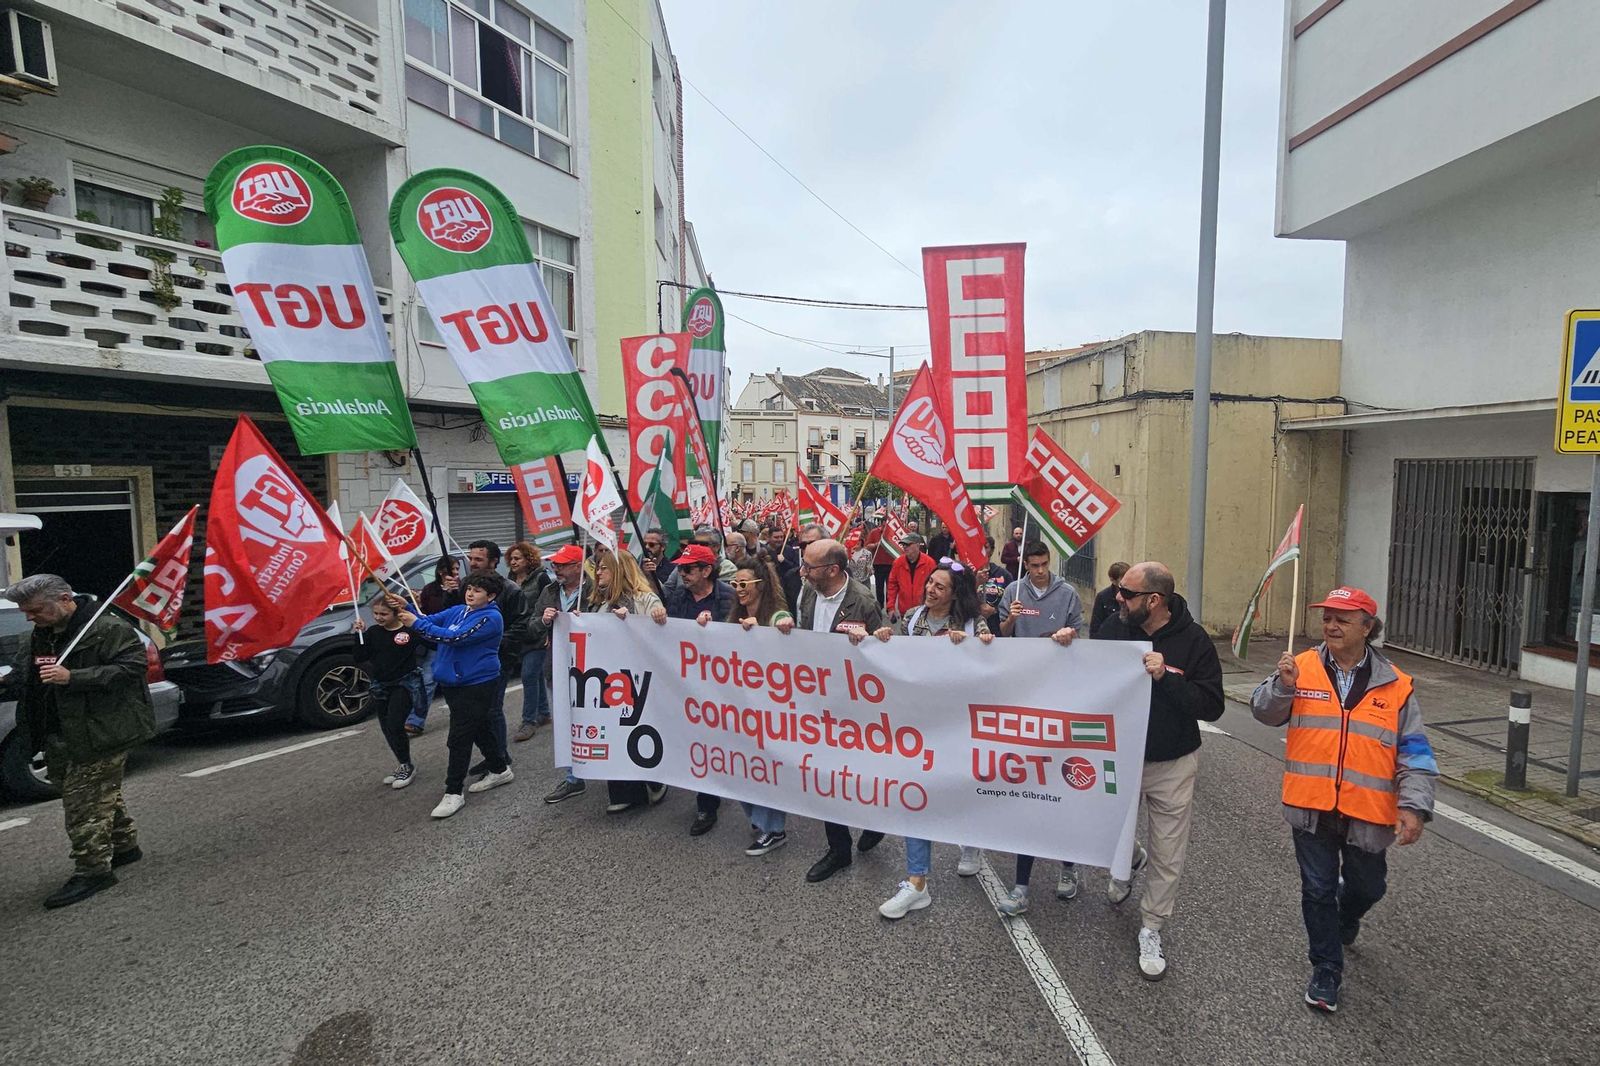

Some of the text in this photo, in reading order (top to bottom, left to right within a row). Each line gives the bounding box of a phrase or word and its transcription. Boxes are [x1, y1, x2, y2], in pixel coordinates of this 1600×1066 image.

[946, 257, 1009, 483] CCOO
[62, 466, 83, 477] 59
[1025, 438, 1109, 525] CCOO
[1050, 498, 1091, 538] Cádiz
[680, 641, 885, 703] Proteger lo
[571, 723, 583, 738] GT
[684, 697, 935, 771] conquistado,
[976, 711, 1064, 741] CCOO
[690, 742, 928, 811] ganar futuro
[972, 748, 1052, 785] UGT
[976, 788, 1007, 798] Campo
[1022, 791, 1062, 802] Gibraltar
